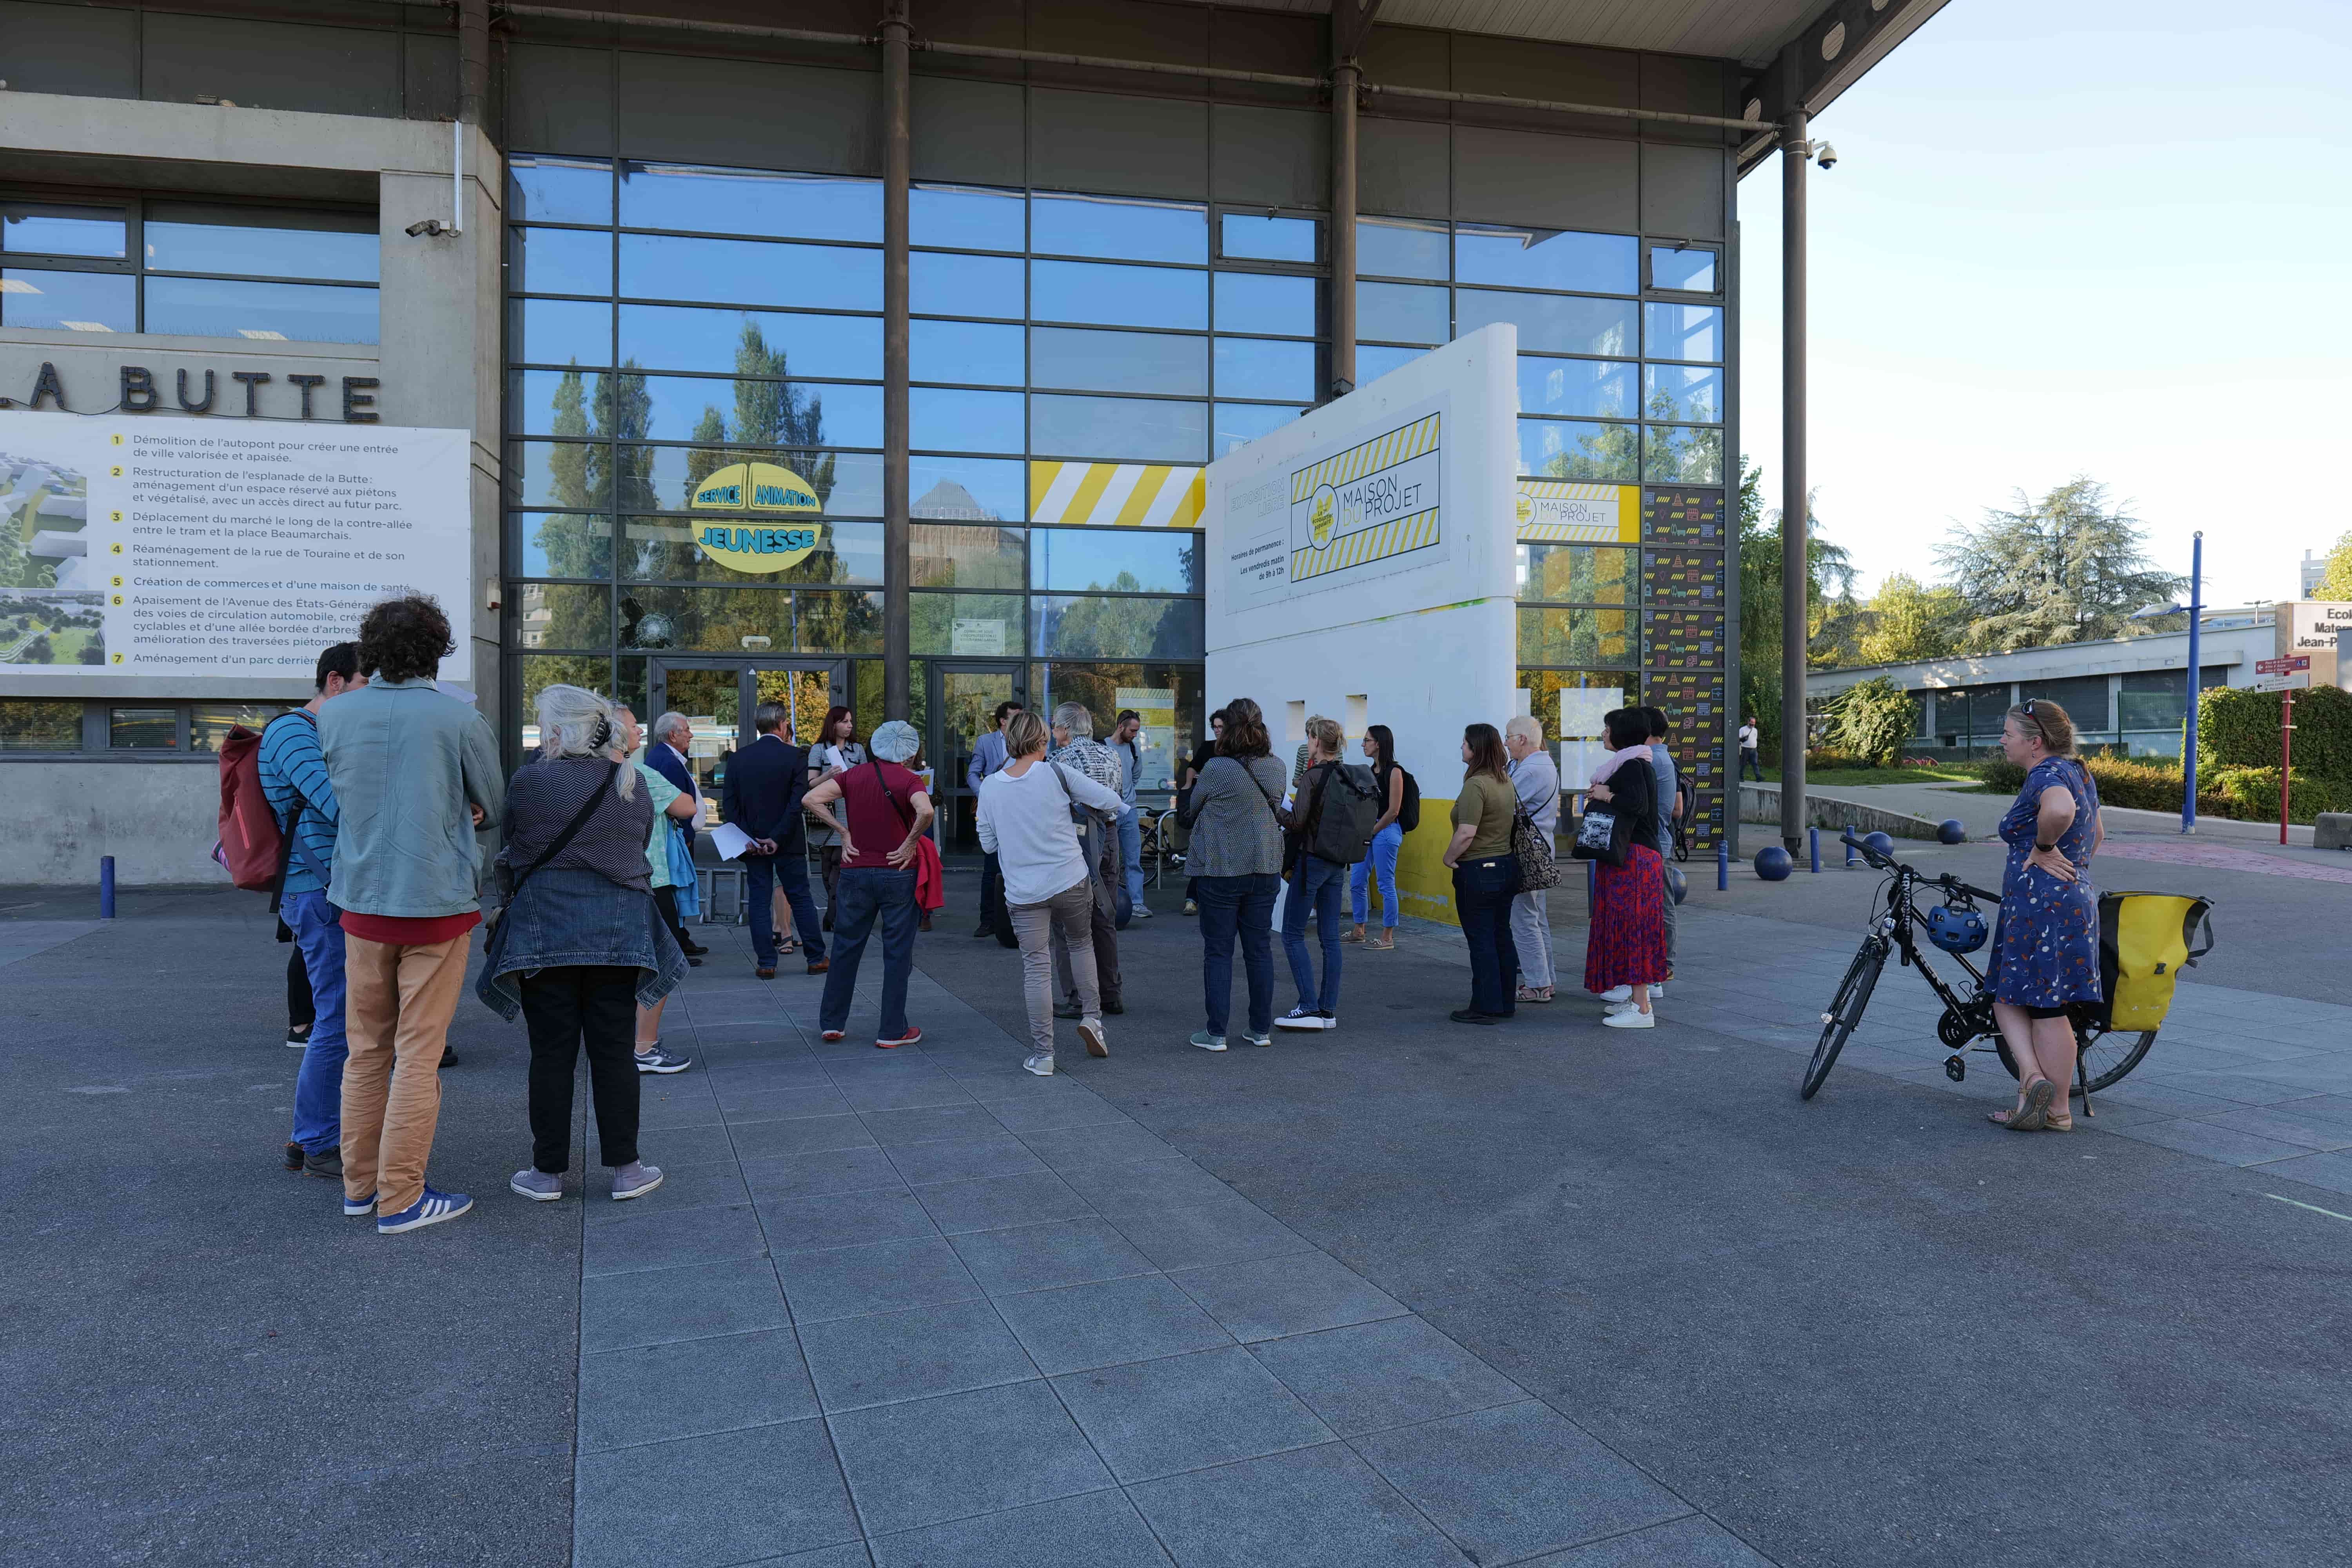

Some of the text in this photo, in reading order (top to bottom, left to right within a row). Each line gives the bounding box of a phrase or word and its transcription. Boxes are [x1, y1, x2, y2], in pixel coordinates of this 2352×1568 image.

[0, 361, 380, 422] A BUTTE
[114, 436, 119, 444] 1
[134, 435, 196, 445] Démolition
[200, 438, 214, 446] de
[218, 438, 275, 449] l'autopont
[308, 443, 336, 451] créer
[151, 449, 174, 458] ville
[178, 450, 229, 459] valorisée
[247, 453, 292, 462] apaisée.
[133, 467, 221, 478] Restructuration
[225, 470, 238, 479] de
[243, 471, 304, 481] l'esplanade
[309, 474, 322, 482] de
[326, 474, 334, 482] la
[133, 481, 215, 491] aménagement
[219, 483, 243, 492] d'un
[247, 486, 285, 494] espace
[289, 485, 329, 494] réservé
[356, 488, 396, 497] piétons
[698, 485, 815, 506] SERVICE ANIMATION
[1231, 477, 1285, 512] EXPOSITION
[1344, 474, 1397, 508] MAISON
[148, 494, 208, 505] végétalisé,
[259, 497, 289, 506] accès
[293, 499, 325, 507] direct
[345, 499, 371, 508] futur
[1258, 494, 1285, 517] LIBRE
[1343, 483, 1421, 527] DU PROJET
[1541, 502, 1587, 513] MAISON
[133, 512, 209, 523] Déplacement
[212, 515, 226, 524] du
[231, 516, 272, 524] marché
[276, 516, 285, 525] le
[289, 517, 312, 527] long
[317, 517, 330, 526] de
[334, 518, 343, 527] la
[347, 520, 412, 529] contre-allée
[1560, 511, 1606, 522] PROJET
[133, 526, 162, 534] entre
[167, 526, 176, 535] le
[180, 527, 205, 535] tram
[225, 528, 234, 536] la
[238, 528, 267, 538] place
[271, 529, 351, 539] Beaumarchais.
[699, 528, 815, 554] JEUNESSE
[133, 544, 230, 555] Réaménagement
[234, 547, 248, 555] de
[252, 548, 260, 556] la
[286, 549, 299, 557] de
[303, 549, 350, 558] Touraine
[368, 551, 382, 559] de
[1231, 551, 1248, 561] Horaires
[1255, 540, 1281, 555] permanence
[133, 558, 218, 568] stationnement.
[1249, 560, 1270, 572] vendredis
[1271, 555, 1284, 565] matin
[134, 577, 182, 586] Création
[186, 578, 200, 586] de
[286, 580, 317, 589] d'une
[321, 582, 360, 590] maison
[133, 596, 201, 605] Apaisement
[205, 597, 219, 605] de
[223, 597, 269, 607] l'Avenue
[273, 599, 292, 607] des
[296, 597, 375, 609] États-Générau
[134, 608, 153, 617] des
[208, 610, 267, 619] circulation
[270, 612, 336, 622] automobile,
[340, 613, 363, 621] créa
[134, 622, 186, 632] cyclables
[204, 623, 235, 632] d'une
[239, 624, 265, 632] allée
[269, 624, 309, 633] bordée
[134, 635, 205, 644] amélioration
[209, 636, 228, 644] des
[232, 637, 289, 645] traversées
[2298, 636, 2337, 647] Jean-P
[133, 653, 218, 664] Aménagement
[221, 655, 245, 664] d'un
